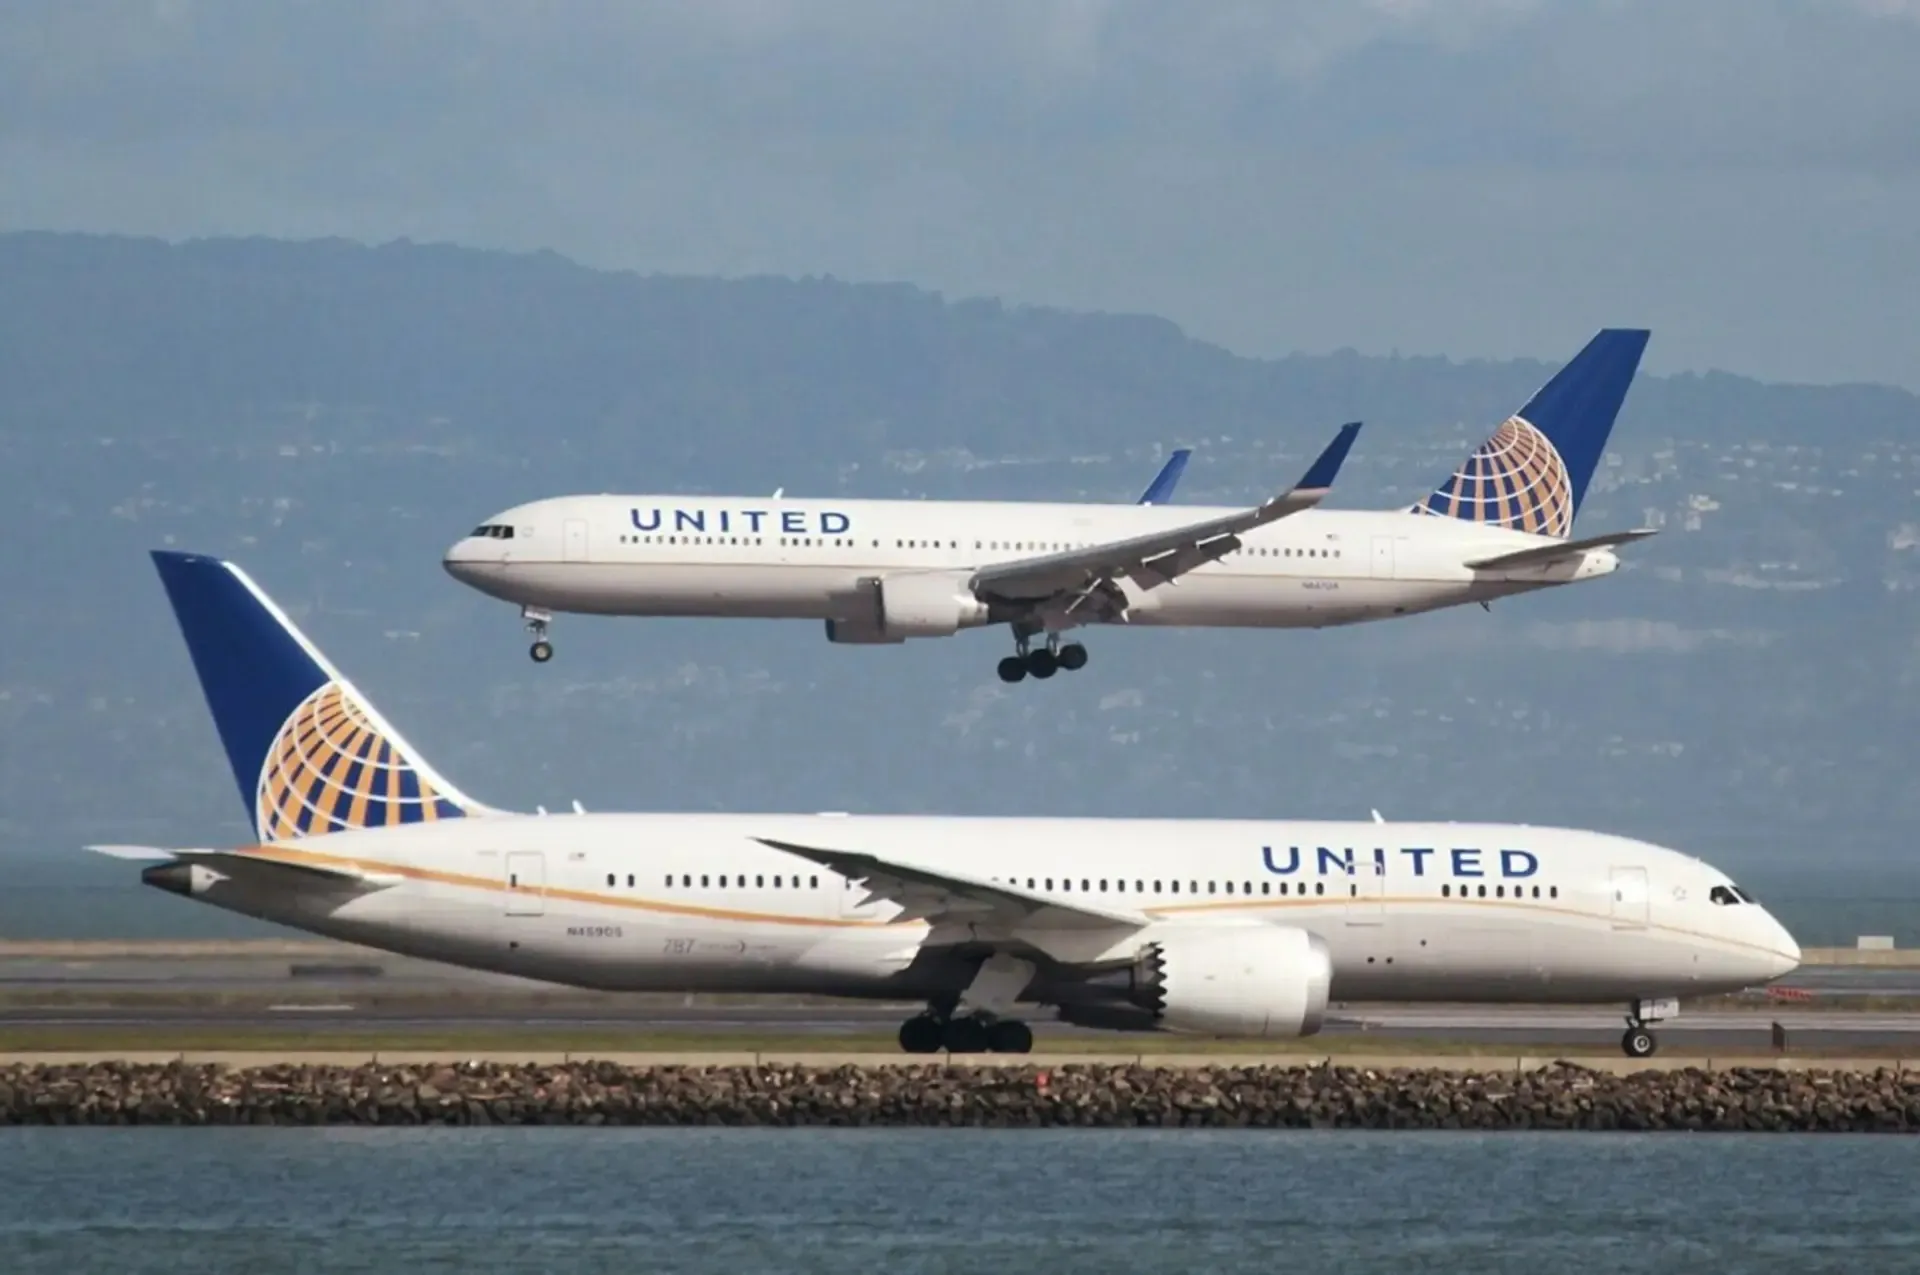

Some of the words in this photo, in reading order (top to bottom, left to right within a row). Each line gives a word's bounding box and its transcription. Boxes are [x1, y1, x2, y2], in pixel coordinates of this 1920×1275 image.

[631, 508, 850, 534] UNITED
[1262, 846, 1538, 877] UNITED
[663, 938, 696, 954] 787
